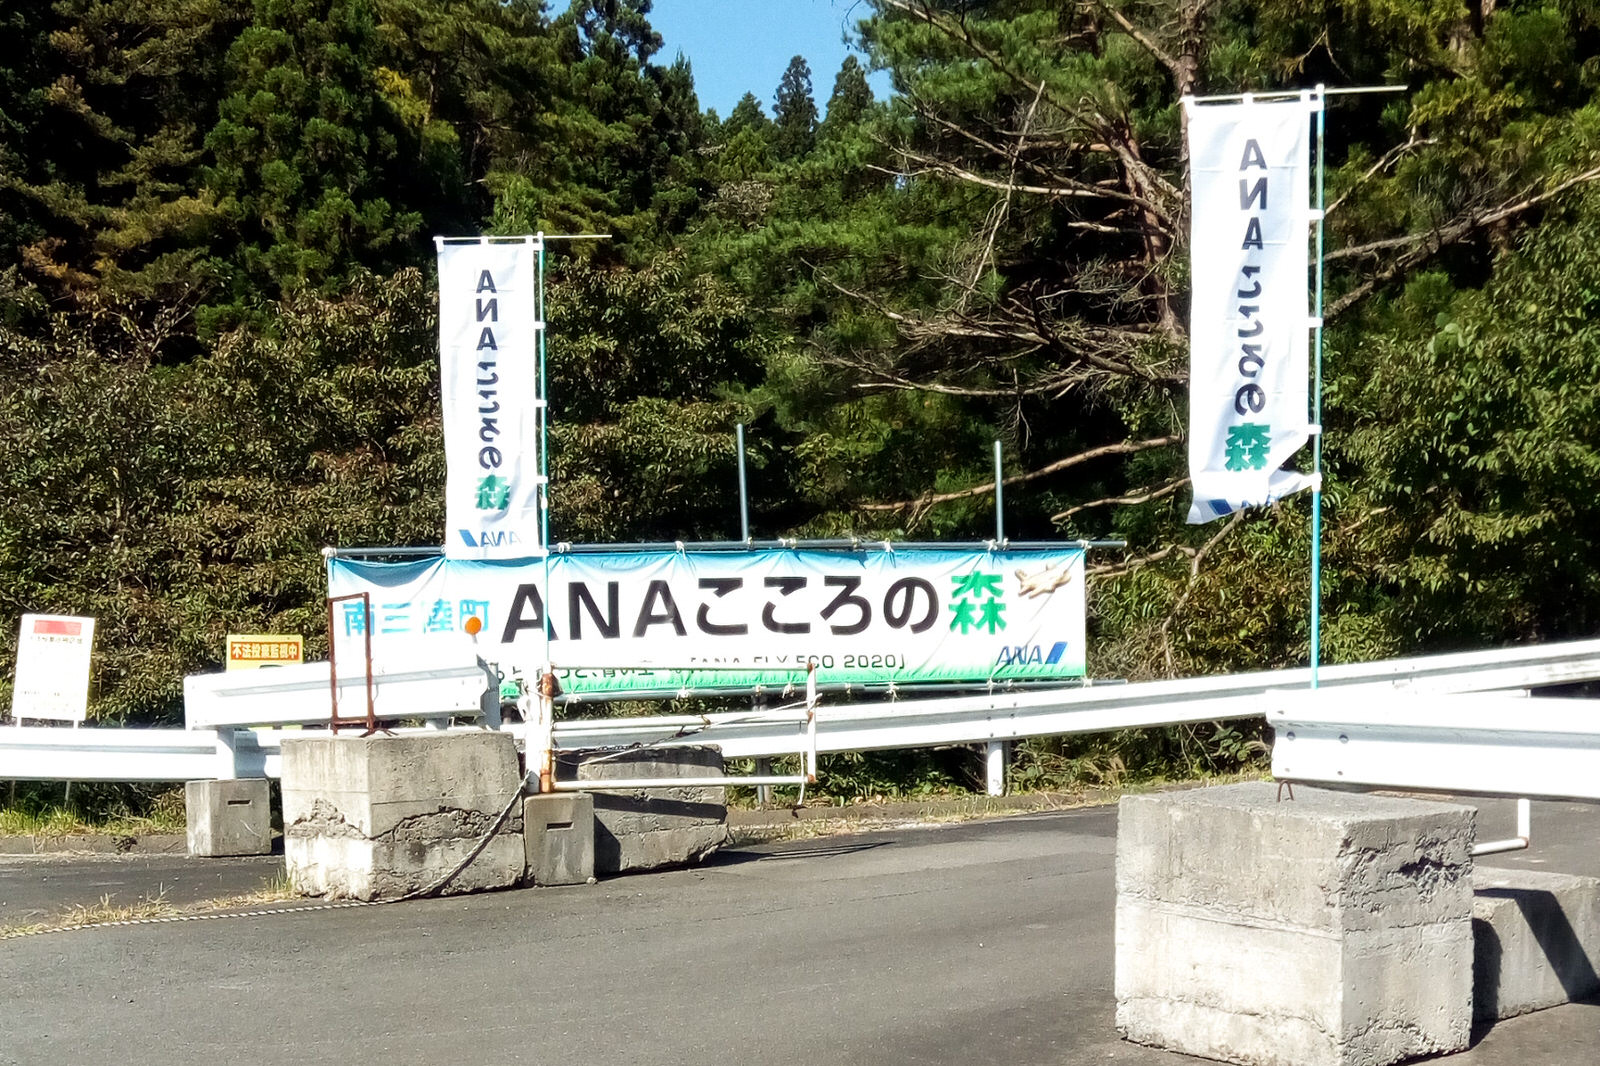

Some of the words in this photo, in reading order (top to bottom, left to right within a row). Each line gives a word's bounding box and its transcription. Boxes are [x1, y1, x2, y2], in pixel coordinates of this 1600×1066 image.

[343, 598, 490, 637] 南三陸町
[501, 570, 1007, 643] ANAこころの森
[996, 645, 1043, 666] ANA
